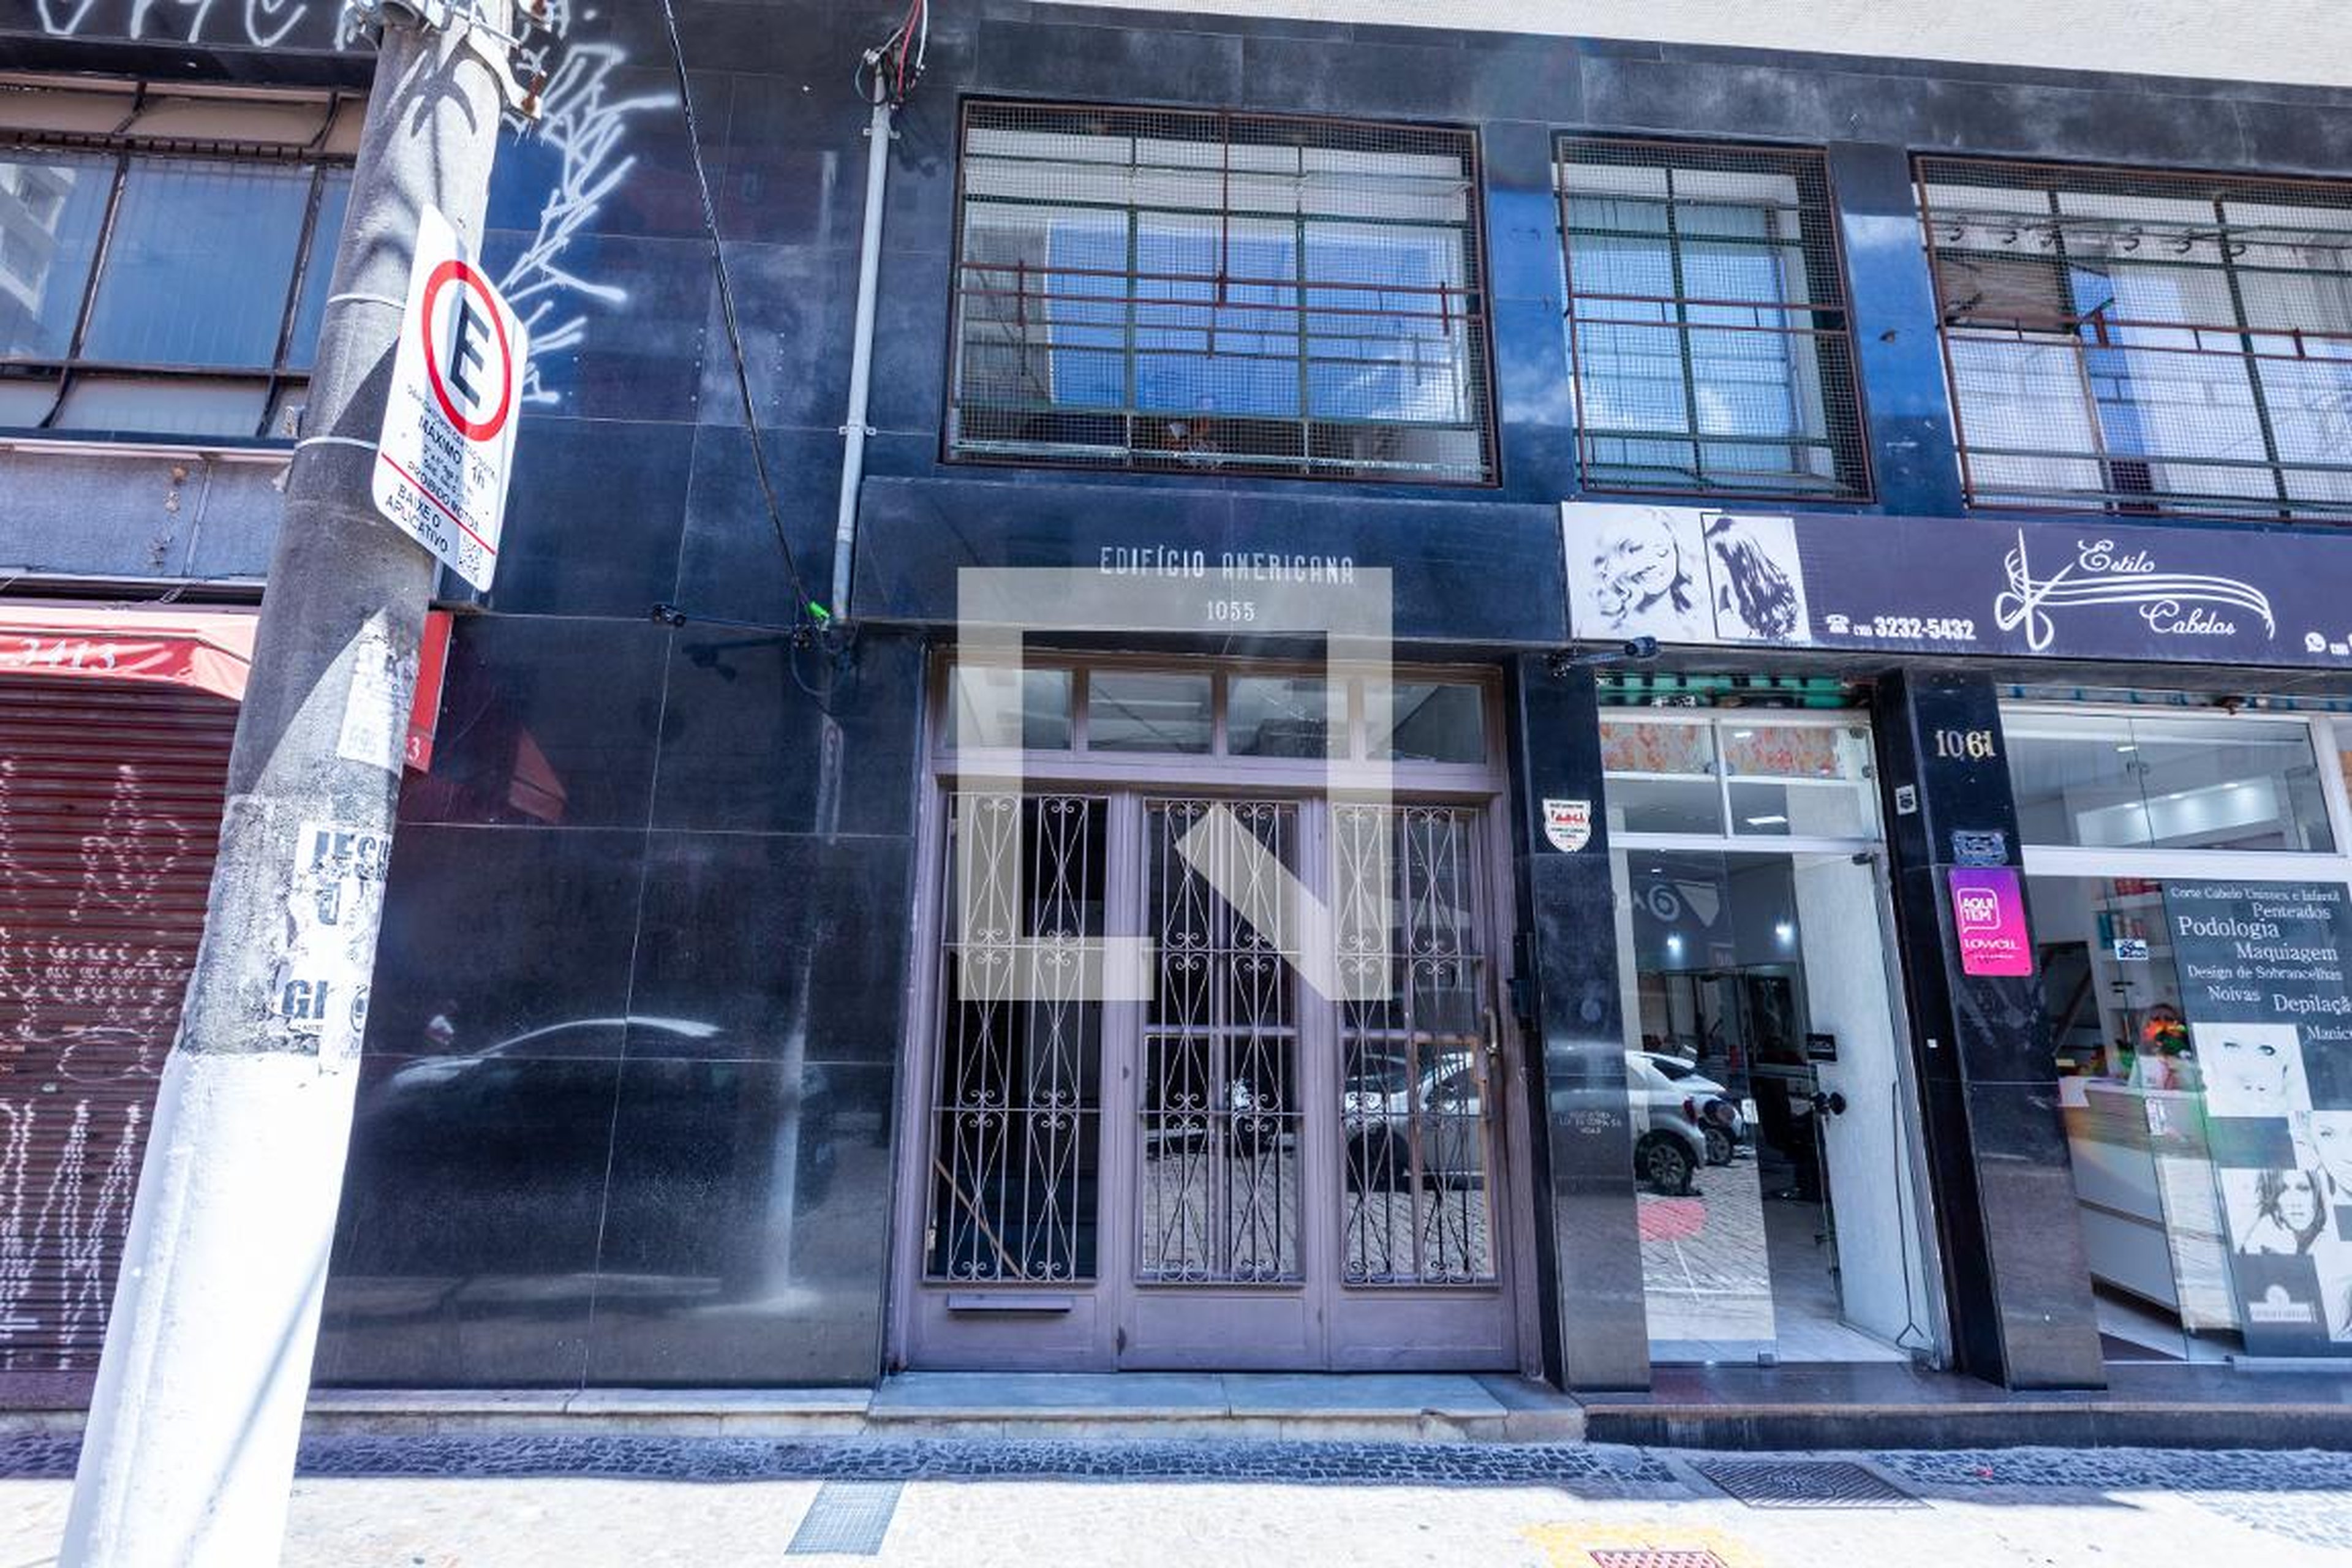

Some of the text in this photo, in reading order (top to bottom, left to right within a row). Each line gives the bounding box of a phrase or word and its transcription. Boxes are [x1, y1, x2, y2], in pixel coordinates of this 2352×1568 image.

[450, 298, 489, 409] E
[398, 483, 441, 528] BAIXE O
[385, 494, 448, 552] APLICATIVO
[1100, 545, 1355, 584] EDIFÍCIO AMERICANA
[2077, 539, 2155, 573] Estilo
[1207, 601, 1256, 622] 1055
[2139, 599, 2237, 635] Cabelos
[1874, 616, 1977, 640] 3232-5432
[1935, 730, 1996, 758] 1061
[2252, 902, 2331, 919] Penteados
[2178, 916, 2280, 940] Podologia
[2235, 941, 2339, 963] Maquiagem
[2187, 965, 2233, 980] Design
[2236, 965, 2253, 979] de
[2207, 985, 2261, 1002] Noivas
[2305, 1025, 2352, 1041] Manic
